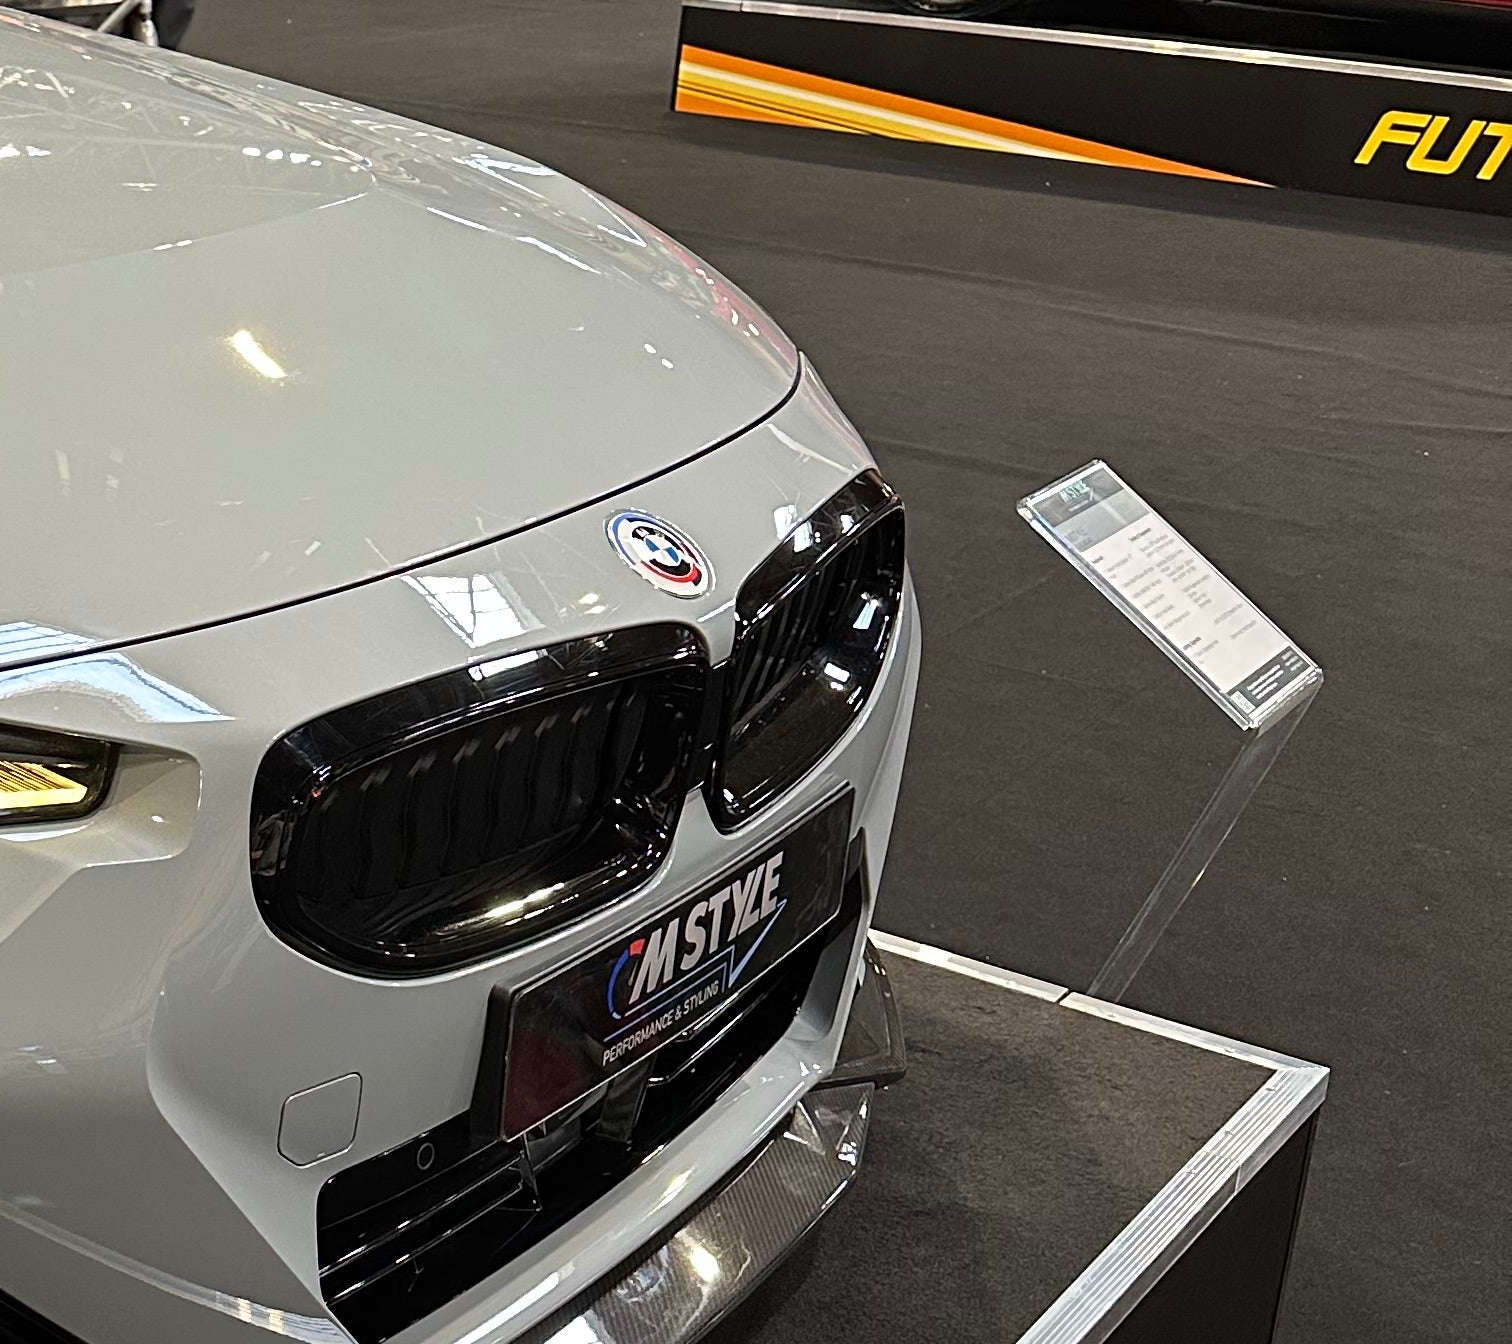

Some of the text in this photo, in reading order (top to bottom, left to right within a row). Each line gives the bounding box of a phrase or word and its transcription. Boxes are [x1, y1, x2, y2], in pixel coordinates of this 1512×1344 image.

[628, 851, 784, 1005] M STYLE
[602, 1013, 674, 1067] PERFORMANCE
[682, 979, 720, 1016] STYLING
